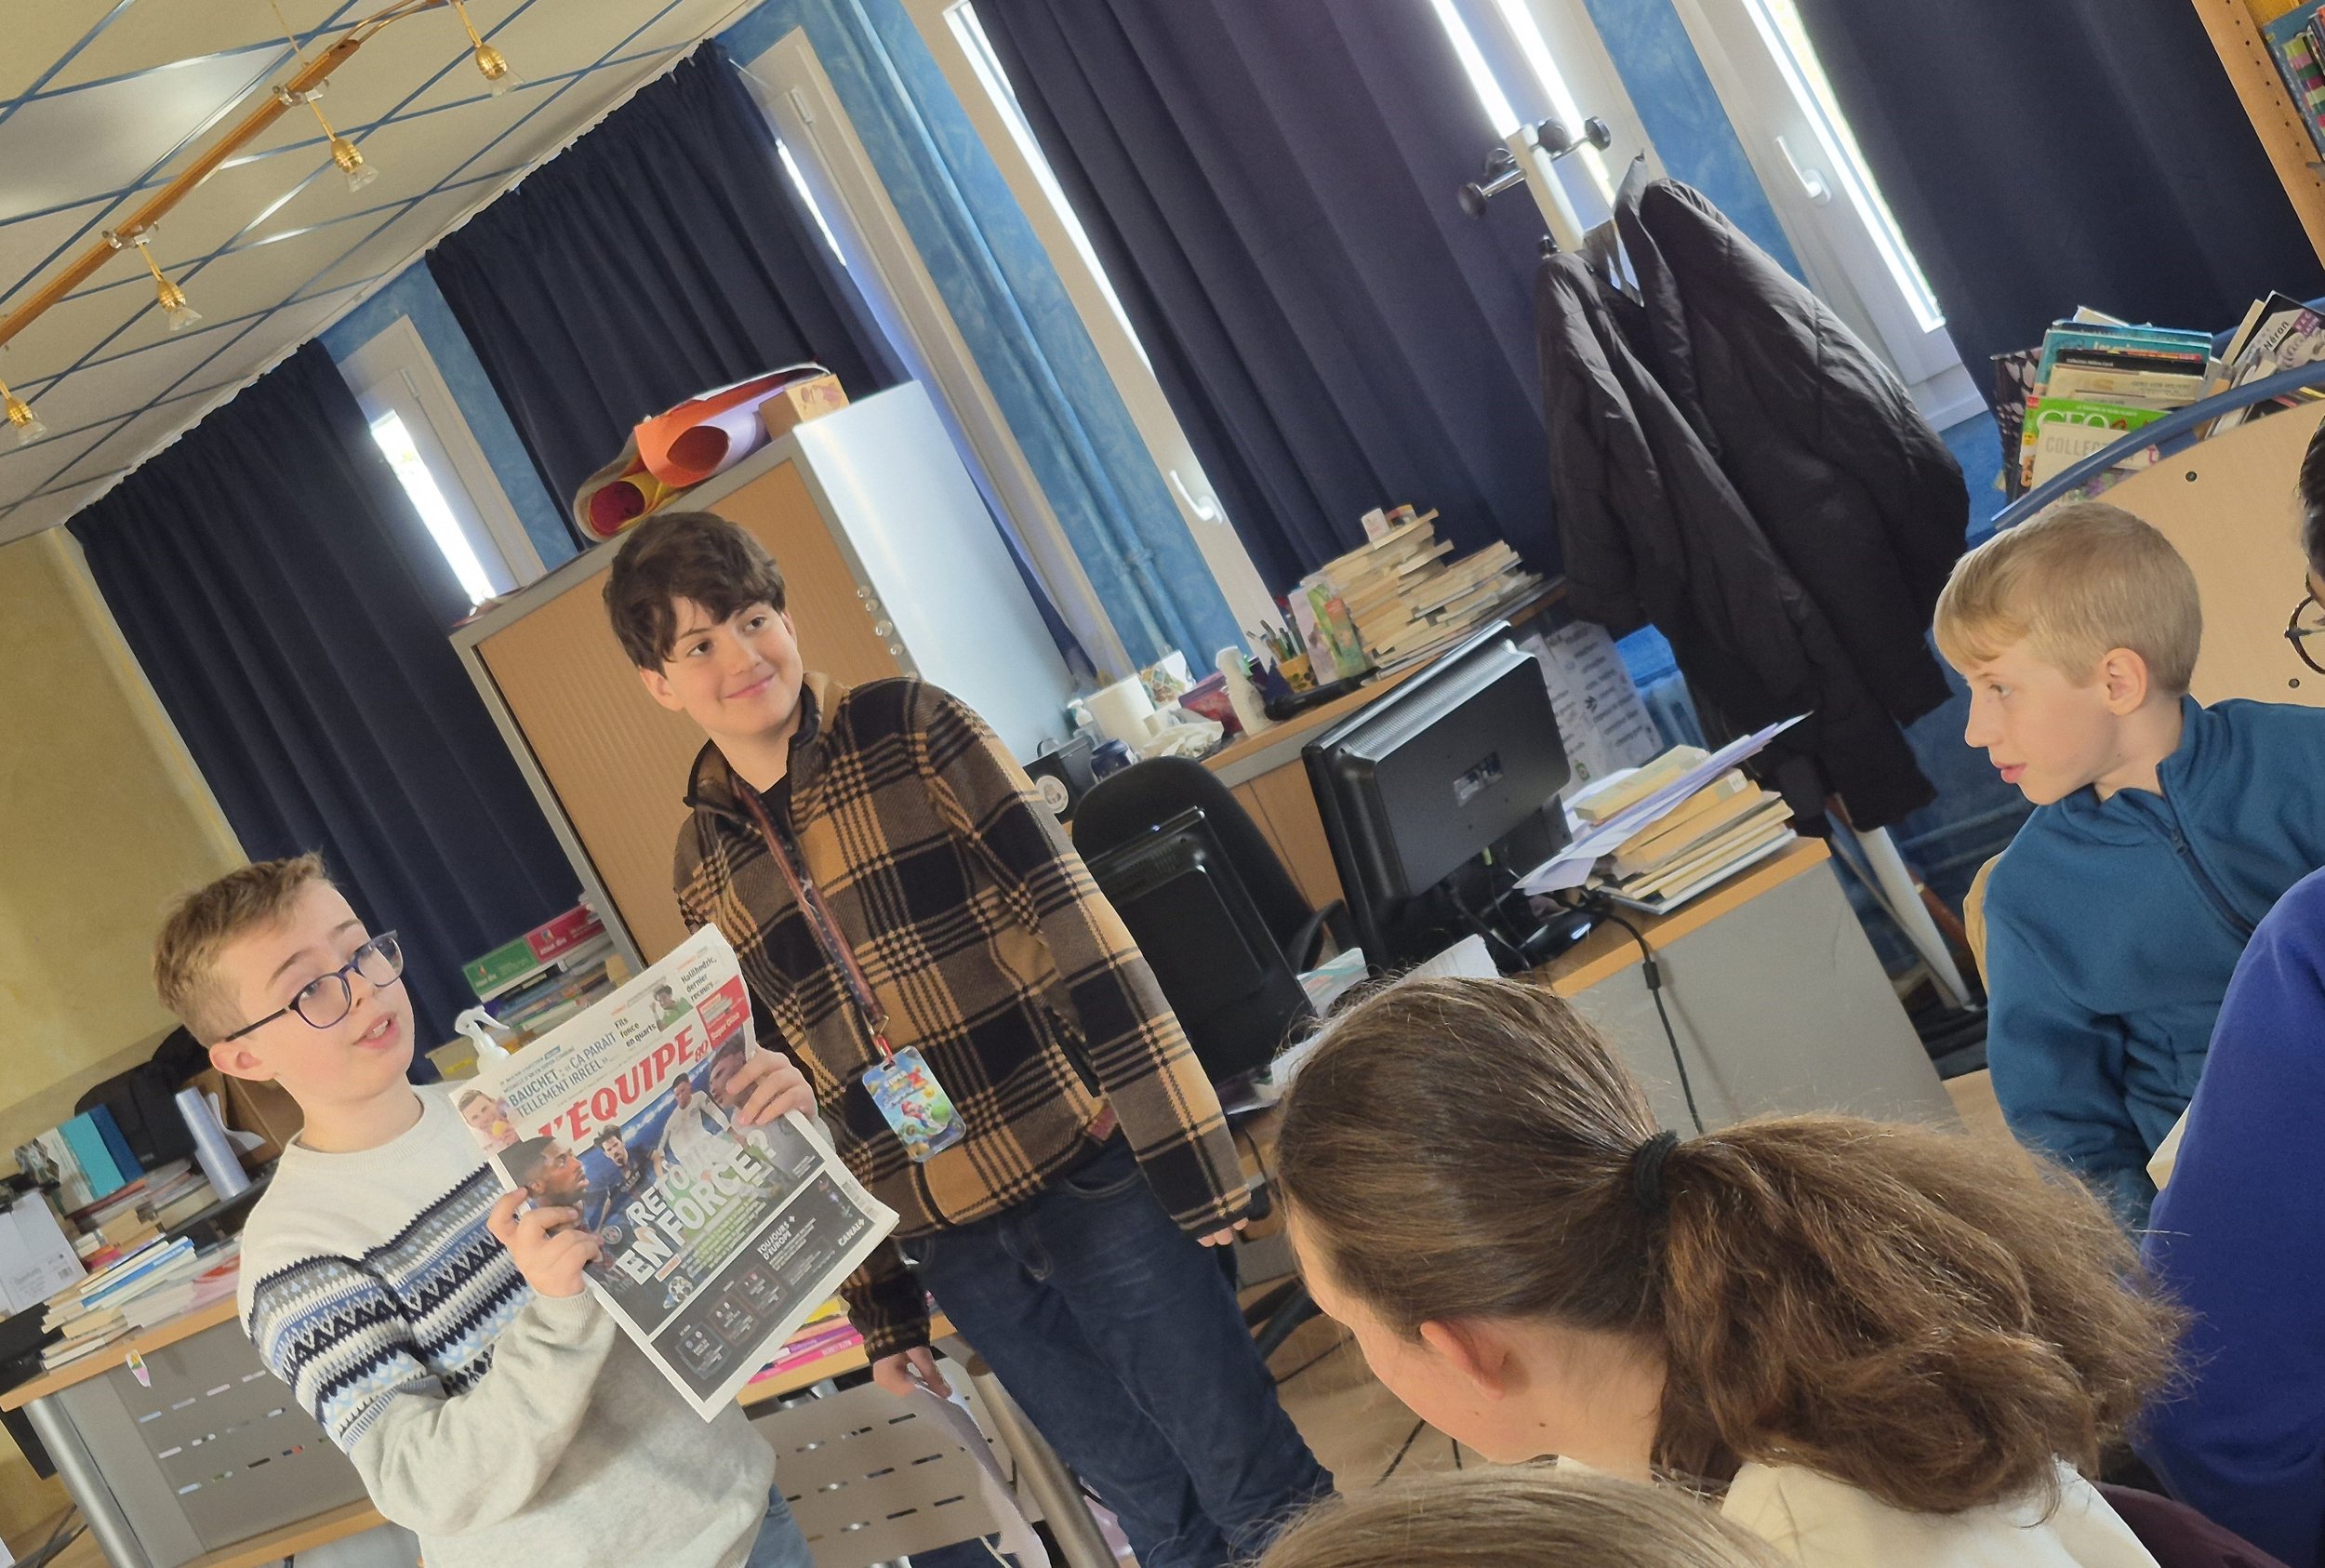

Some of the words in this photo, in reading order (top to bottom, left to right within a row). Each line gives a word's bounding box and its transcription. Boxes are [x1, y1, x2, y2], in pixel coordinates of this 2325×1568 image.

[2264, 321, 2289, 351] Néron
[686, 973, 708, 992] dernier
[691, 981, 714, 1002] recours
[614, 1017, 629, 1030] Fils
[620, 1022, 640, 1039] fonce
[626, 1037, 636, 1047] en
[634, 1024, 657, 1044] quarts
[508, 1070, 558, 1108] BAUCHET
[516, 1082, 572, 1118] TELLEMENT
[571, 1057, 603, 1086] IRRÉEL
[626, 1132, 733, 1227] RETOUR
[616, 1231, 673, 1285] EN
[656, 1143, 763, 1247] FORCE
[757, 1221, 790, 1255] TOUJOURS
[763, 1230, 791, 1261] D'EUROPE
